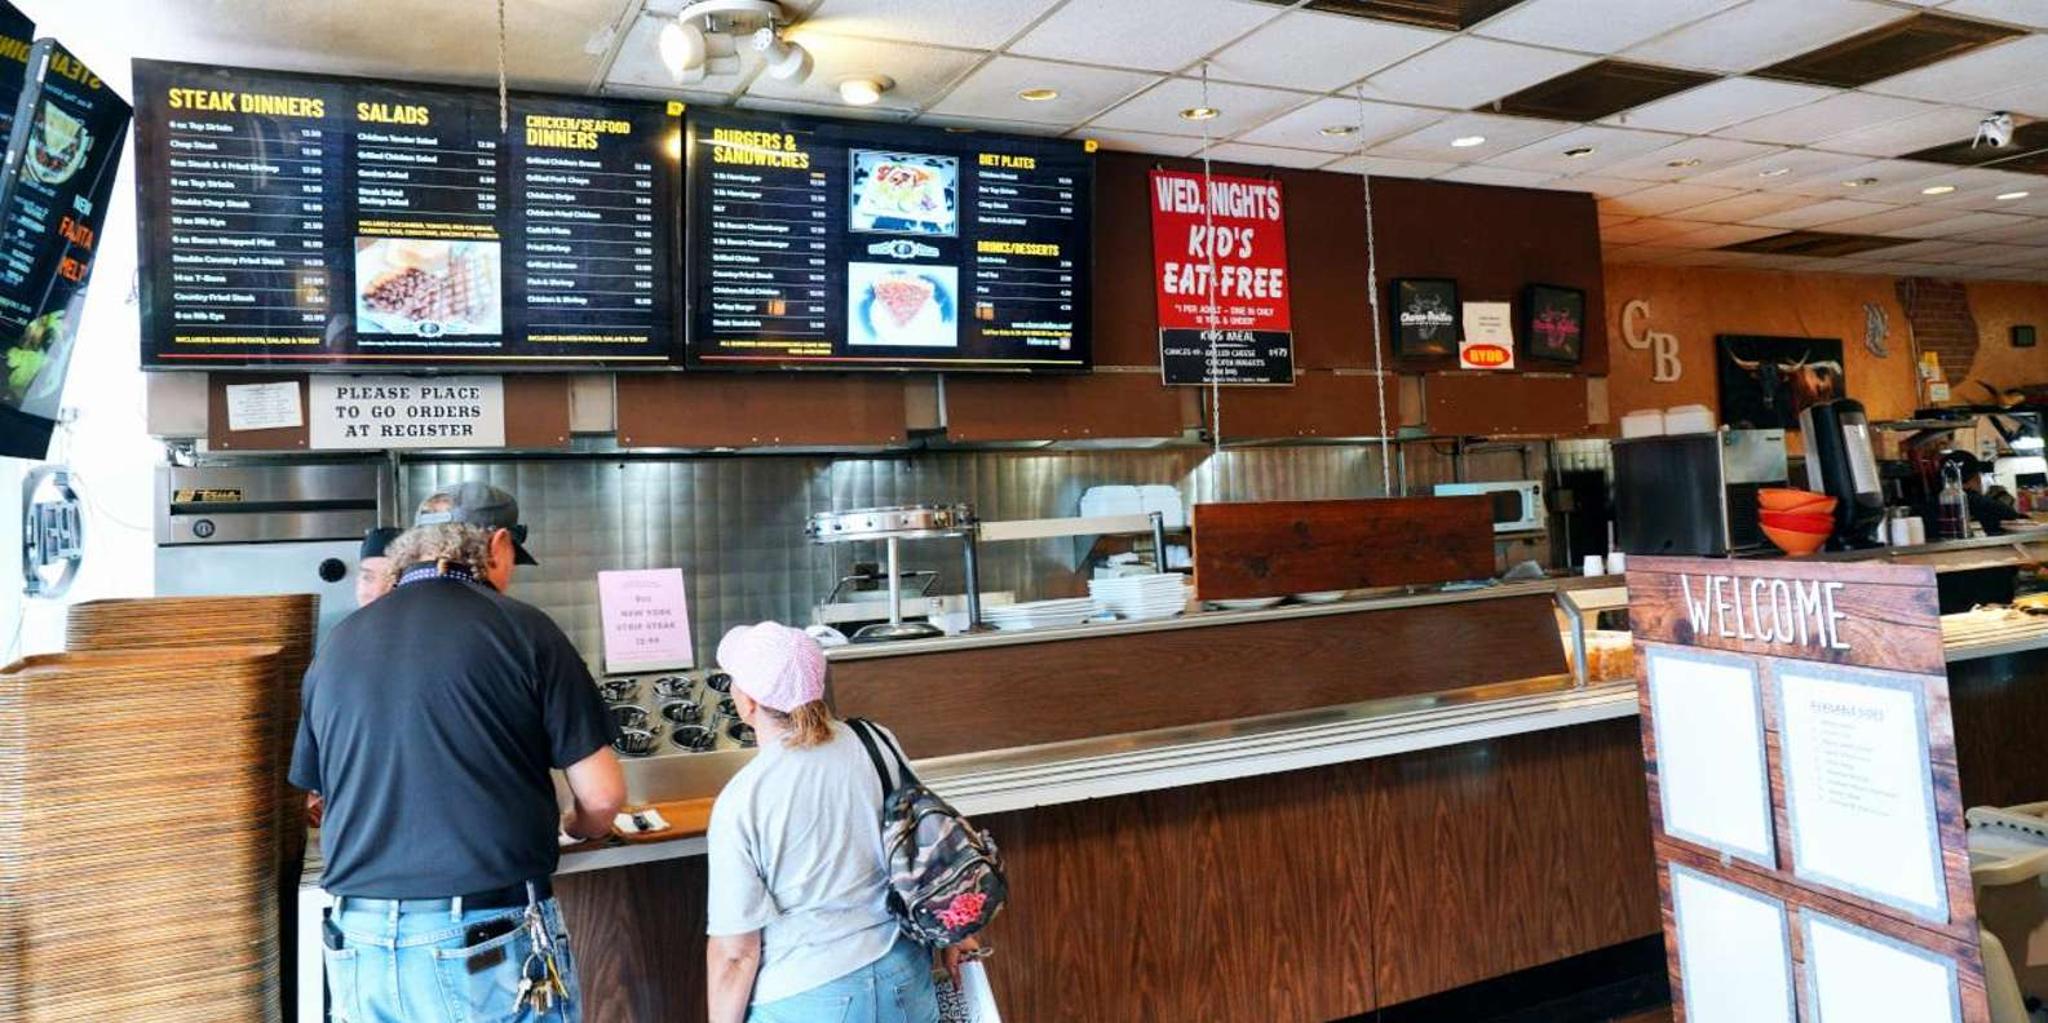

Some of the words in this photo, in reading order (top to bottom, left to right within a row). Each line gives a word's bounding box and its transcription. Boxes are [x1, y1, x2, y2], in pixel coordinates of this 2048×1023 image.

[169, 88, 236, 112] STEAK
[240, 93, 325, 118] DINNERS
[357, 102, 429, 126] SALADS
[526, 114, 631, 134] CHICKEN/SEAFOOD
[170, 140, 192, 150] Chop
[193, 142, 218, 150] Steak
[357, 133, 388, 142] Chicken
[389, 134, 415, 143] Tender
[416, 137, 438, 145] Salad
[526, 128, 599, 150] DINNERS
[713, 127, 782, 150] BURGERS
[784, 133, 796, 151] &
[357, 152, 384, 160] Grilled
[385, 153, 415, 161] Chicken
[416, 155, 438, 163] Salad
[550, 158, 577, 167] Chicken
[713, 146, 810, 169] SANDWICHES
[1001, 154, 1036, 170] PLATES
[188, 160, 211, 169] Steak
[228, 163, 249, 171] Fried
[250, 164, 280, 174] Shrimp
[387, 171, 409, 179] Salad
[358, 197, 387, 206] Shrimp
[387, 199, 409, 207] Salad
[526, 191, 554, 200] Chicken
[1156, 176, 1205, 214] WED.
[1210, 182, 1280, 220] NIGHTS
[171, 198, 202, 206] Double
[203, 200, 225, 208] Chop
[226, 200, 250, 208] Steak
[526, 209, 554, 217] Chicken
[574, 211, 601, 219] Chicken
[218, 238, 255, 247] Wrapped
[1189, 225, 1254, 259] KID'S
[173, 255, 203, 263] Double
[204, 255, 238, 266] Country
[239, 257, 260, 265] Fried
[261, 257, 285, 265] Steak
[1163, 262, 1211, 295] EAT
[1220, 265, 1284, 299] FREE
[174, 293, 208, 302] Country
[232, 294, 256, 302] Steak
[527, 295, 556, 304] Chicken
[563, 296, 588, 306] Shrimp
[1226, 331, 1256, 342] MEAL
[1622, 299, 1653, 349] C
[1651, 332, 1683, 383] B
[1470, 349, 1504, 362] BYOB
[336, 387, 411, 400] PLEASE
[420, 387, 481, 400] PLACE
[335, 406, 360, 418] TO
[371, 406, 396, 418] GO
[407, 406, 481, 418] ORDERS
[345, 425, 370, 438] AT
[381, 425, 474, 437] REGISTER
[1681, 574, 1851, 649] WELCOME
